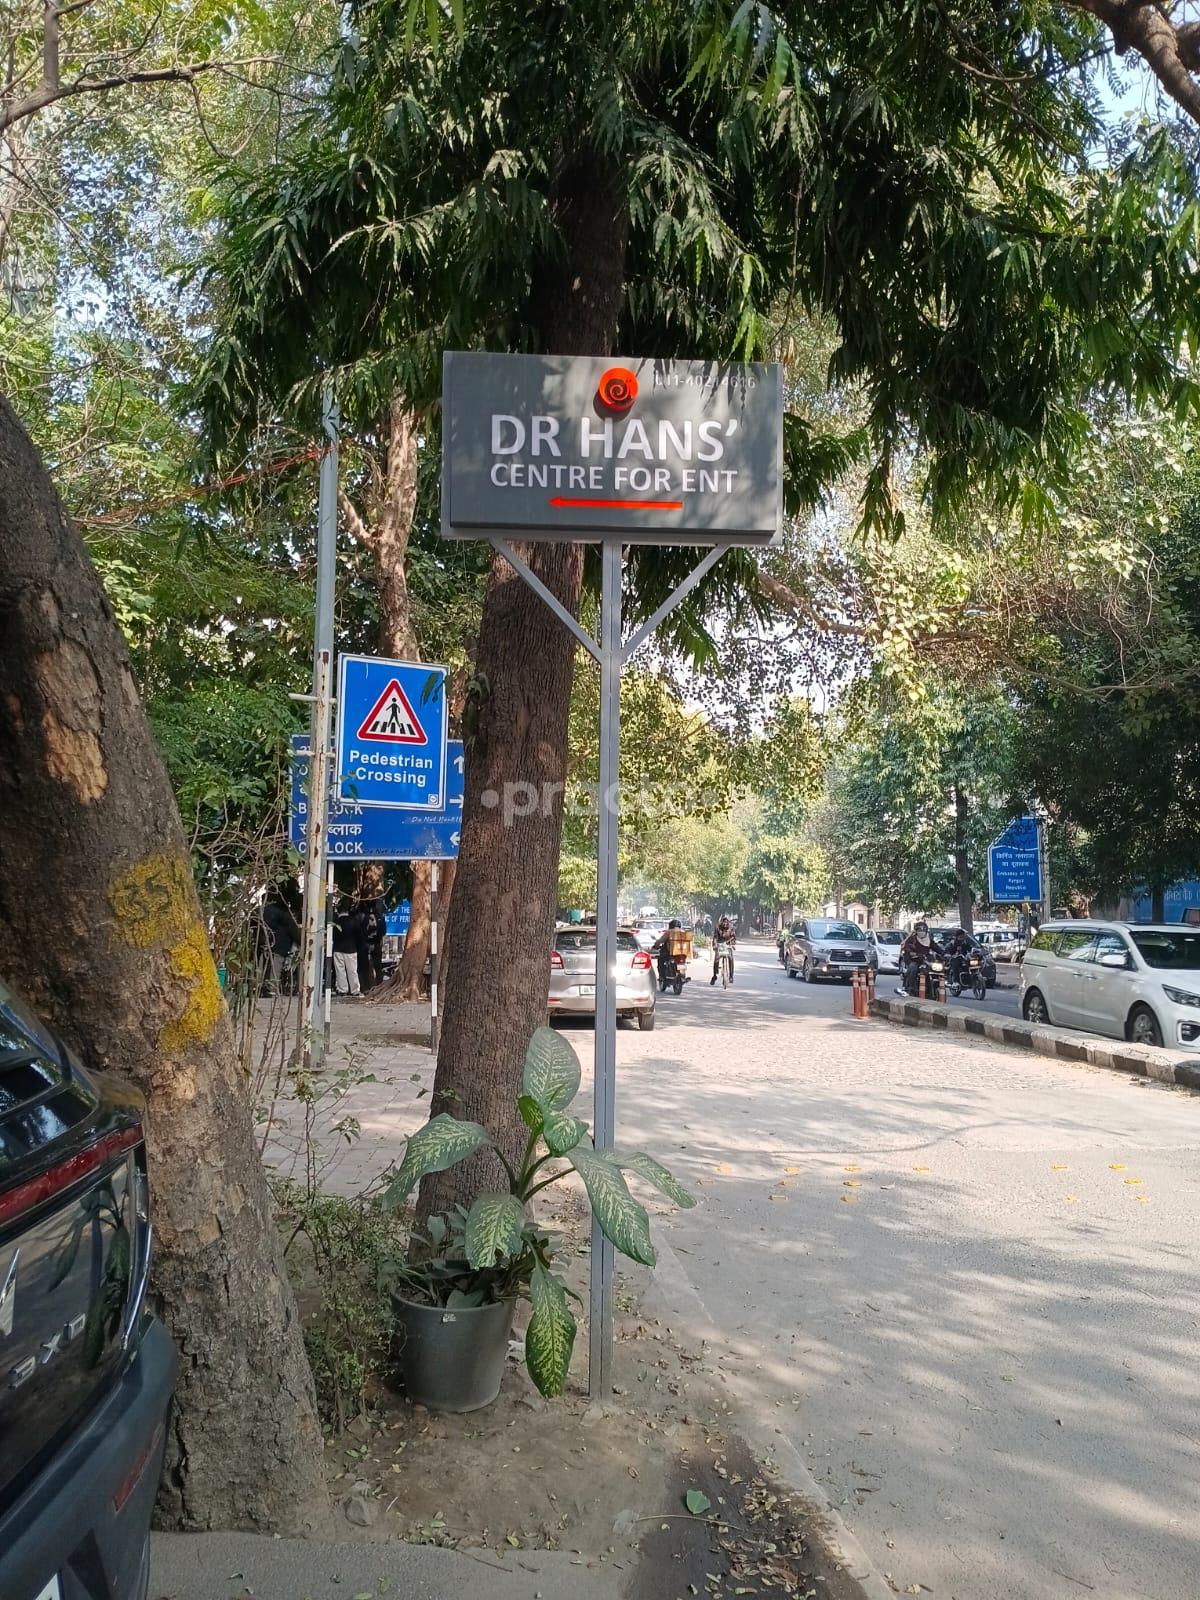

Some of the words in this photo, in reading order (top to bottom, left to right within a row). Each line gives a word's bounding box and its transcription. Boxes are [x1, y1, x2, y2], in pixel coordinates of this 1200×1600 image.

[491, 414, 561, 457] DR
[581, 416, 738, 462] HANS'
[490, 463, 603, 490] CENTRE
[614, 467, 671, 492] FOR
[682, 469, 738, 493] ENT
[349, 750, 433, 769] Pedestrian
[355, 767, 427, 787] Crossing
[326, 841, 364, 854] LOCK
